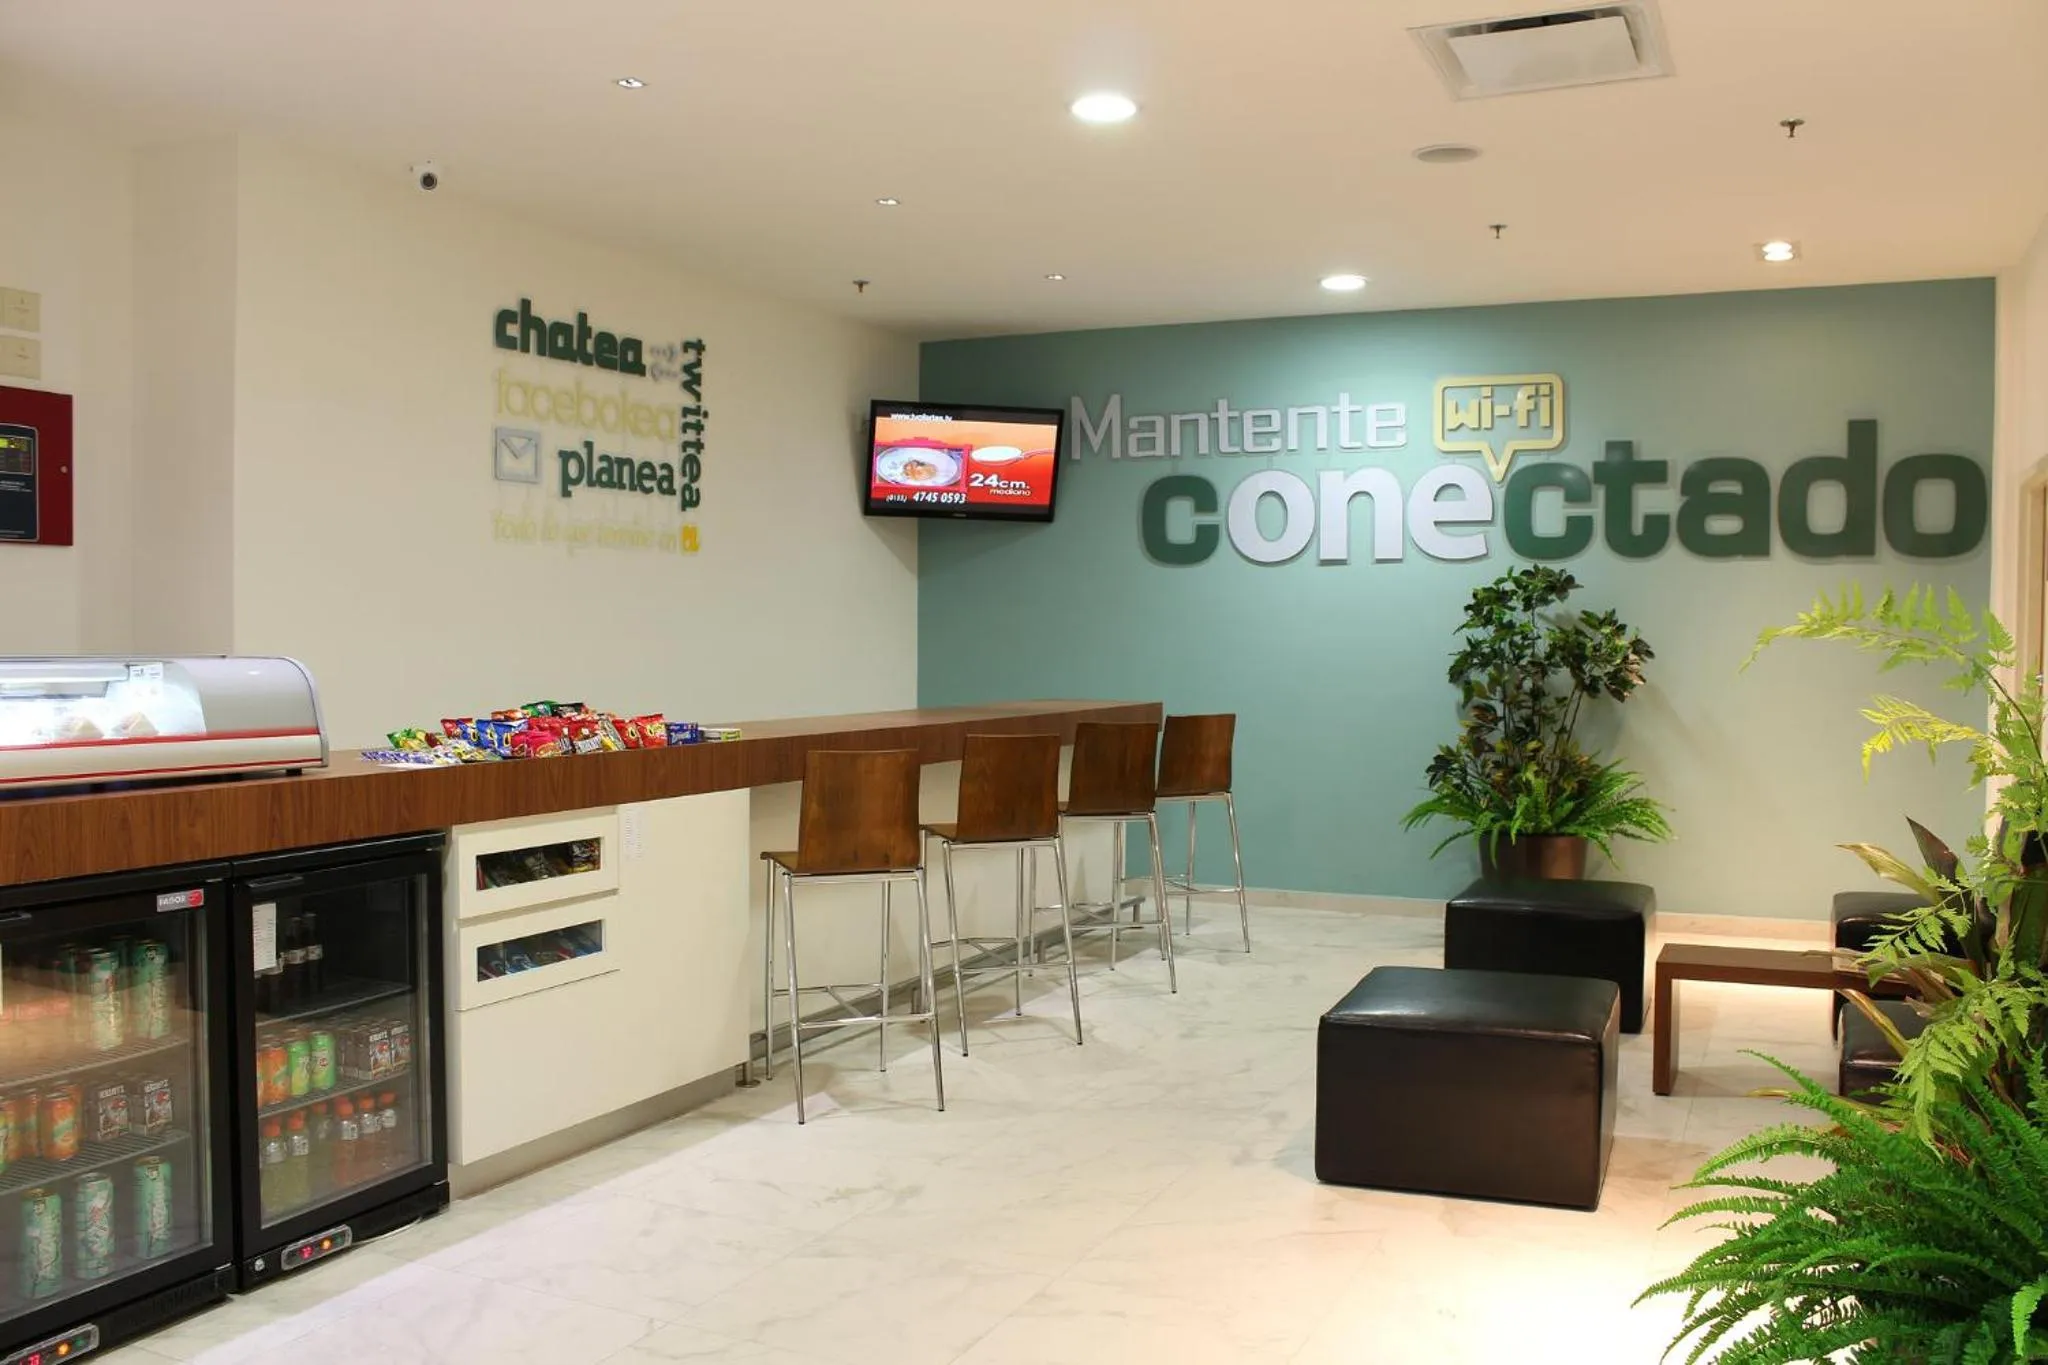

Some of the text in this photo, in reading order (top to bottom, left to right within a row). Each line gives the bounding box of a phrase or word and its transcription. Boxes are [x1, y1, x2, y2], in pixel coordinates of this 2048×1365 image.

[495, 298, 646, 377] chatea
[681, 339, 708, 511] twittea
[1070, 392, 1408, 460] Mantente
[1445, 383, 1553, 430] wi-fi
[558, 440, 677, 498] planea
[912, 490, 939, 503] 4745
[940, 492, 967, 504] 0593
[1141, 419, 1988, 566] conectado
